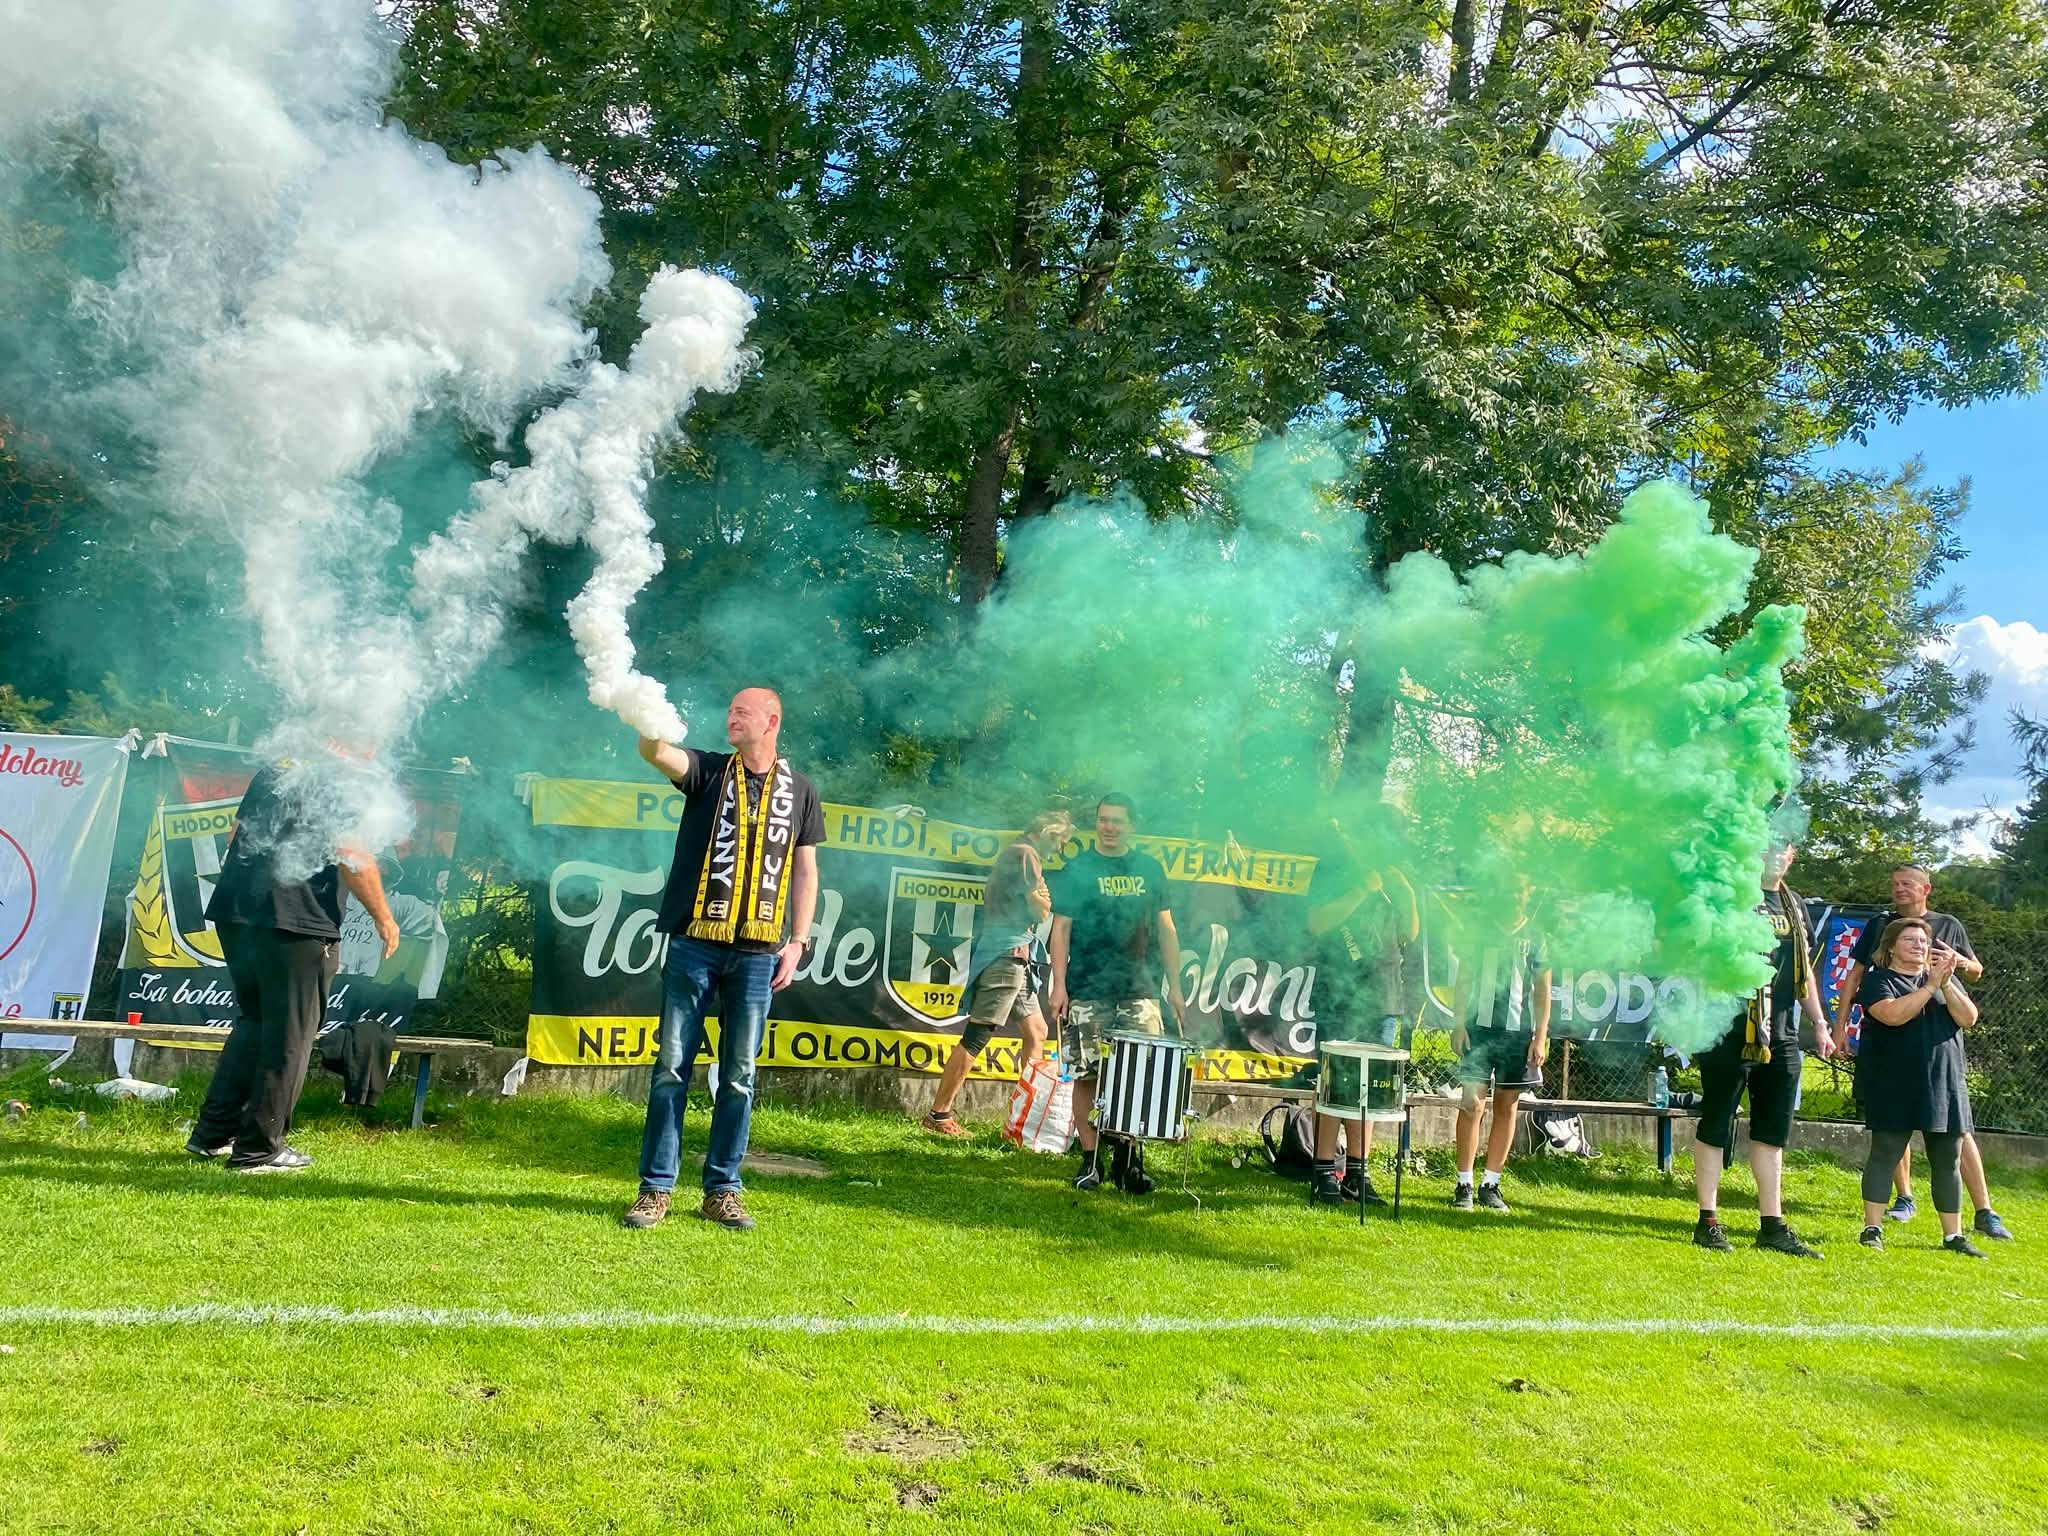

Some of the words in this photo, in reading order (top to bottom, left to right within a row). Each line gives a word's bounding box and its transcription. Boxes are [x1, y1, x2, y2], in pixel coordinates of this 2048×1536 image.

[762, 854, 783, 892] FC
[343, 928, 373, 945] 1912
[923, 991, 955, 1006] 1912
[791, 1031, 1023, 1074] OLOMOUKÝ
